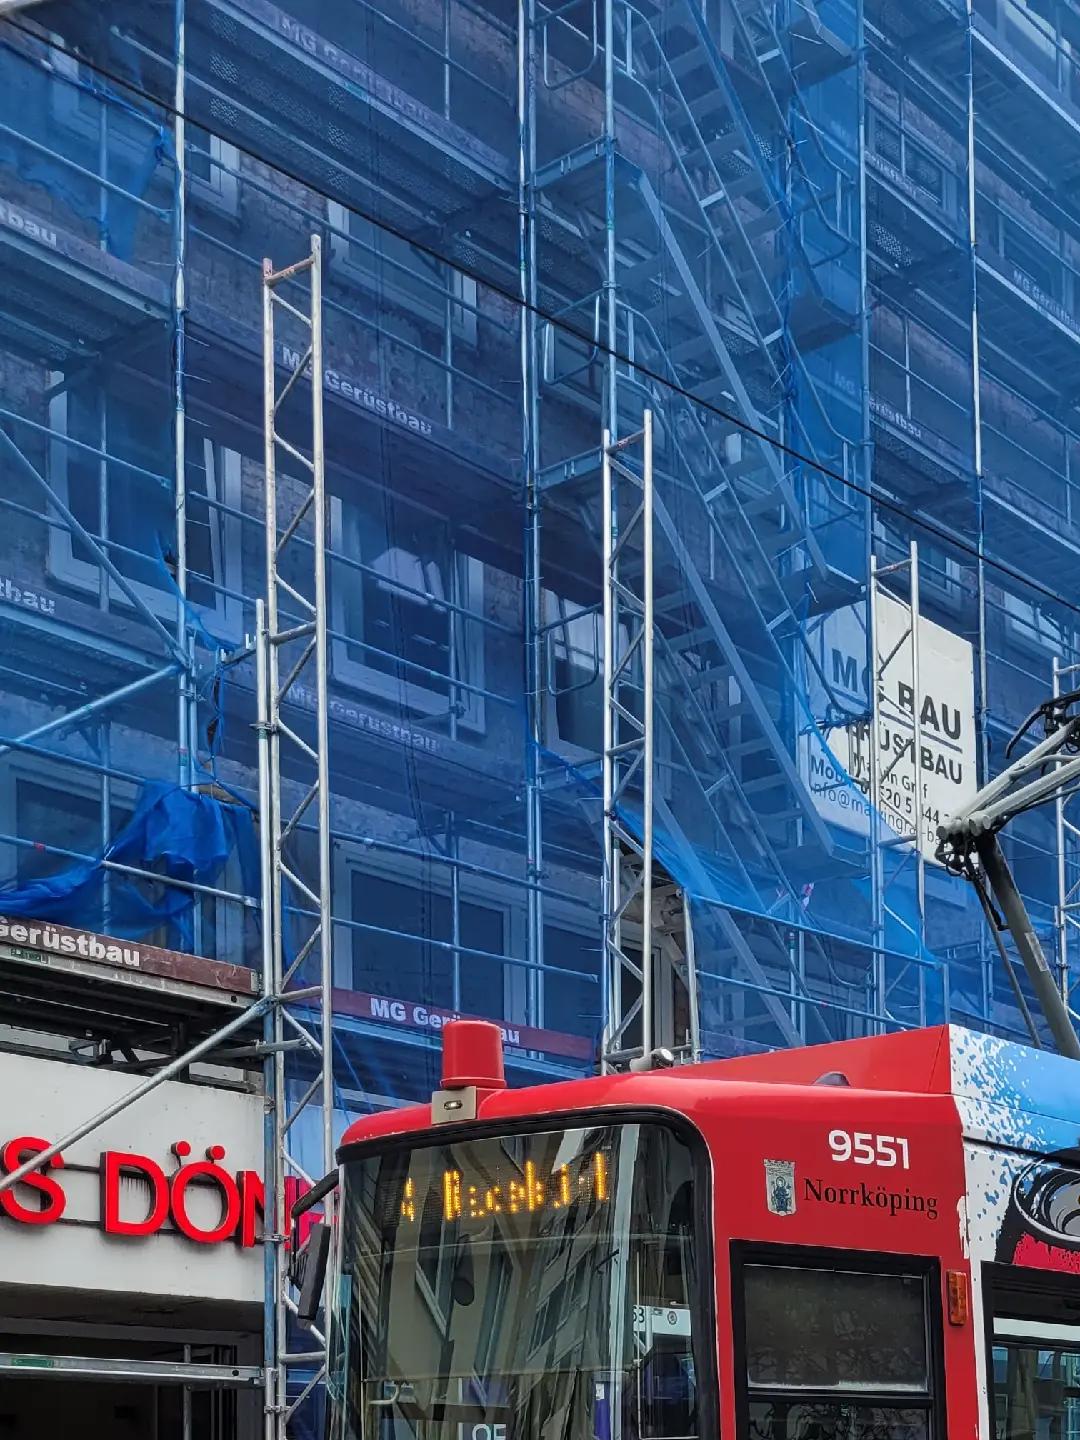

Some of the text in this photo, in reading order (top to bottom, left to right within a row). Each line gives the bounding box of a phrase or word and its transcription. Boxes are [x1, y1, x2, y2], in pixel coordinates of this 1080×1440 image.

[324, 369, 432, 436] Gerüstbau
[898, 680, 962, 741] BAU
[901, 775, 928, 799] Grf
[370, 997, 406, 1022] MG
[828, 1129, 910, 1170] 9551
[804, 1177, 938, 1220] Norrköping
